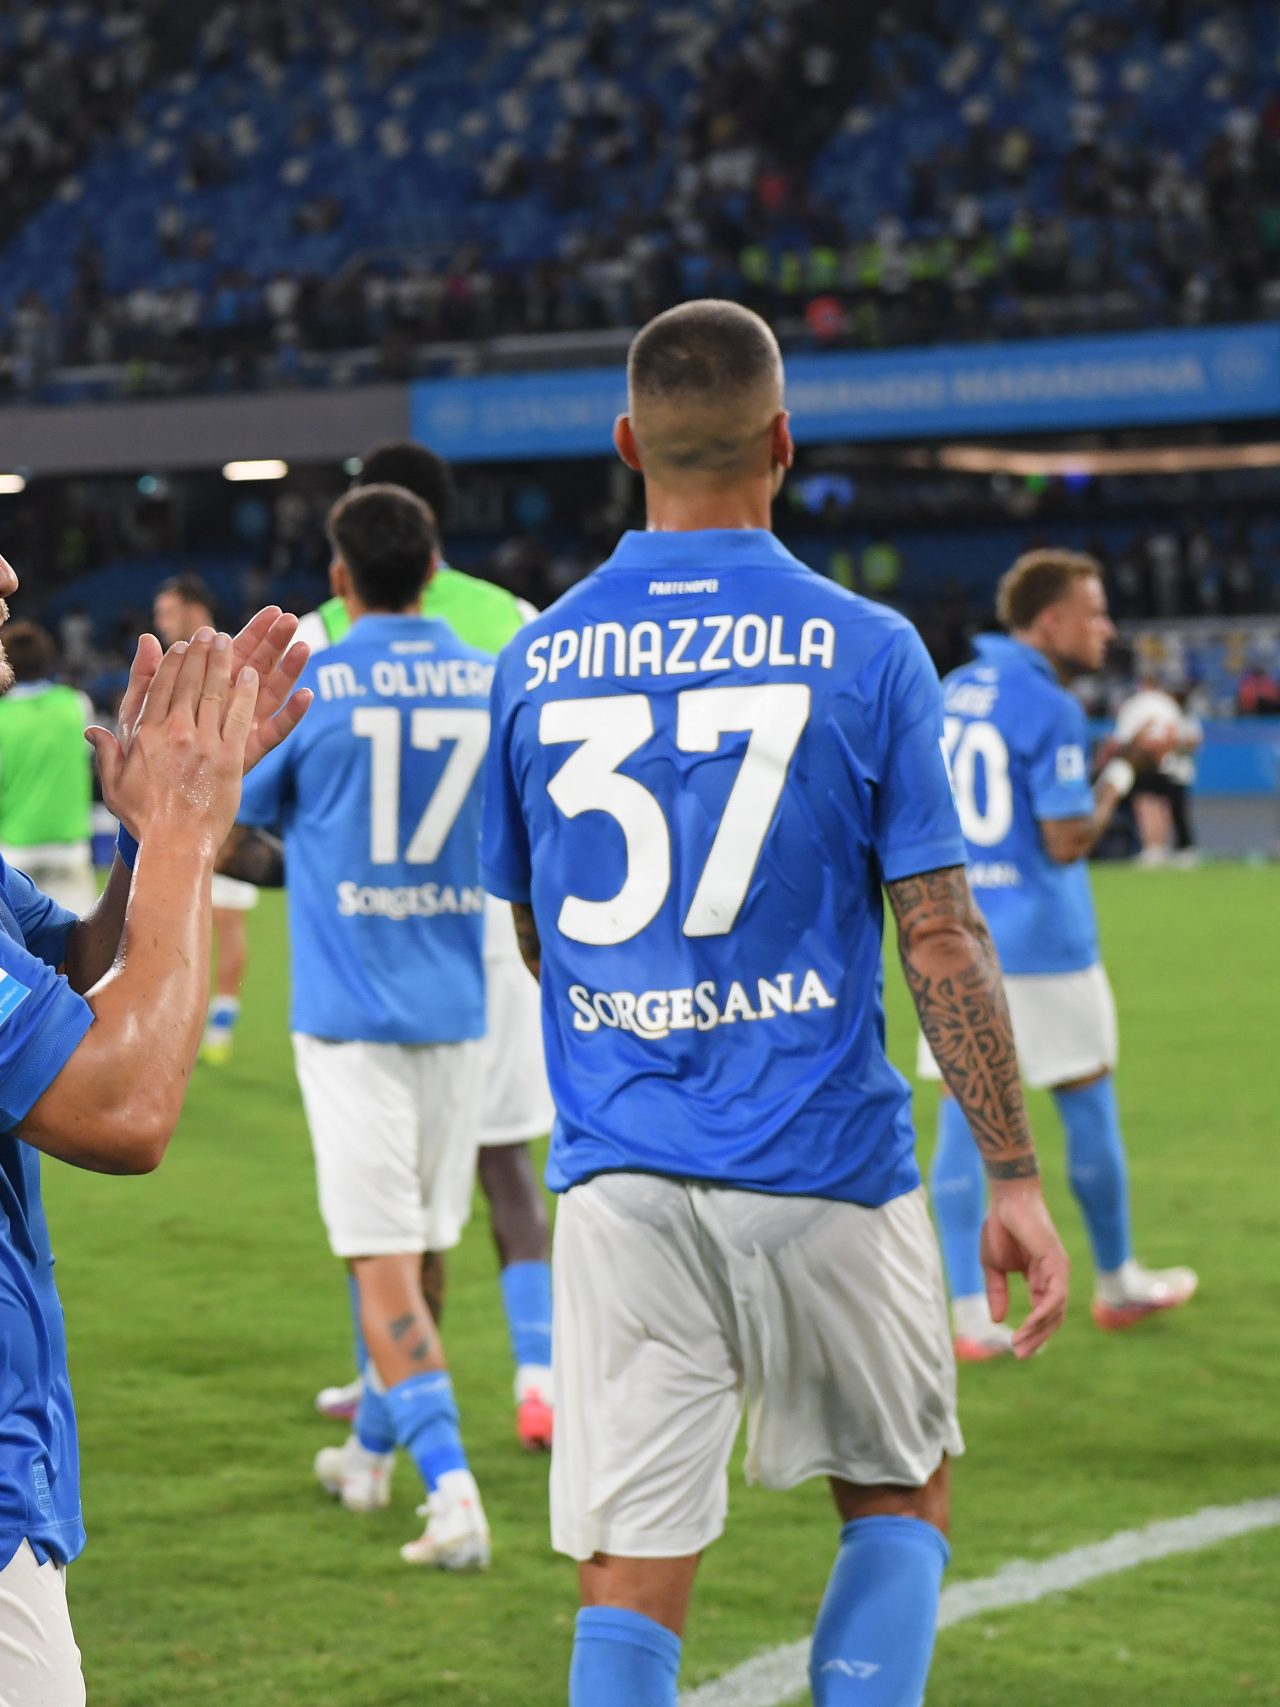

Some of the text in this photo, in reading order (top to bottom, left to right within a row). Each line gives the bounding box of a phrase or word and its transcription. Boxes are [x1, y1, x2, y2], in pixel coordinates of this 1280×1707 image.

[317, 661, 367, 700] M.
[525, 613, 836, 692] SPINAZZOLA
[351, 706, 491, 865] 17
[538, 683, 811, 946] 37
[336, 880, 486, 920] SORGESAN
[568, 968, 837, 1040] SORGESANA
